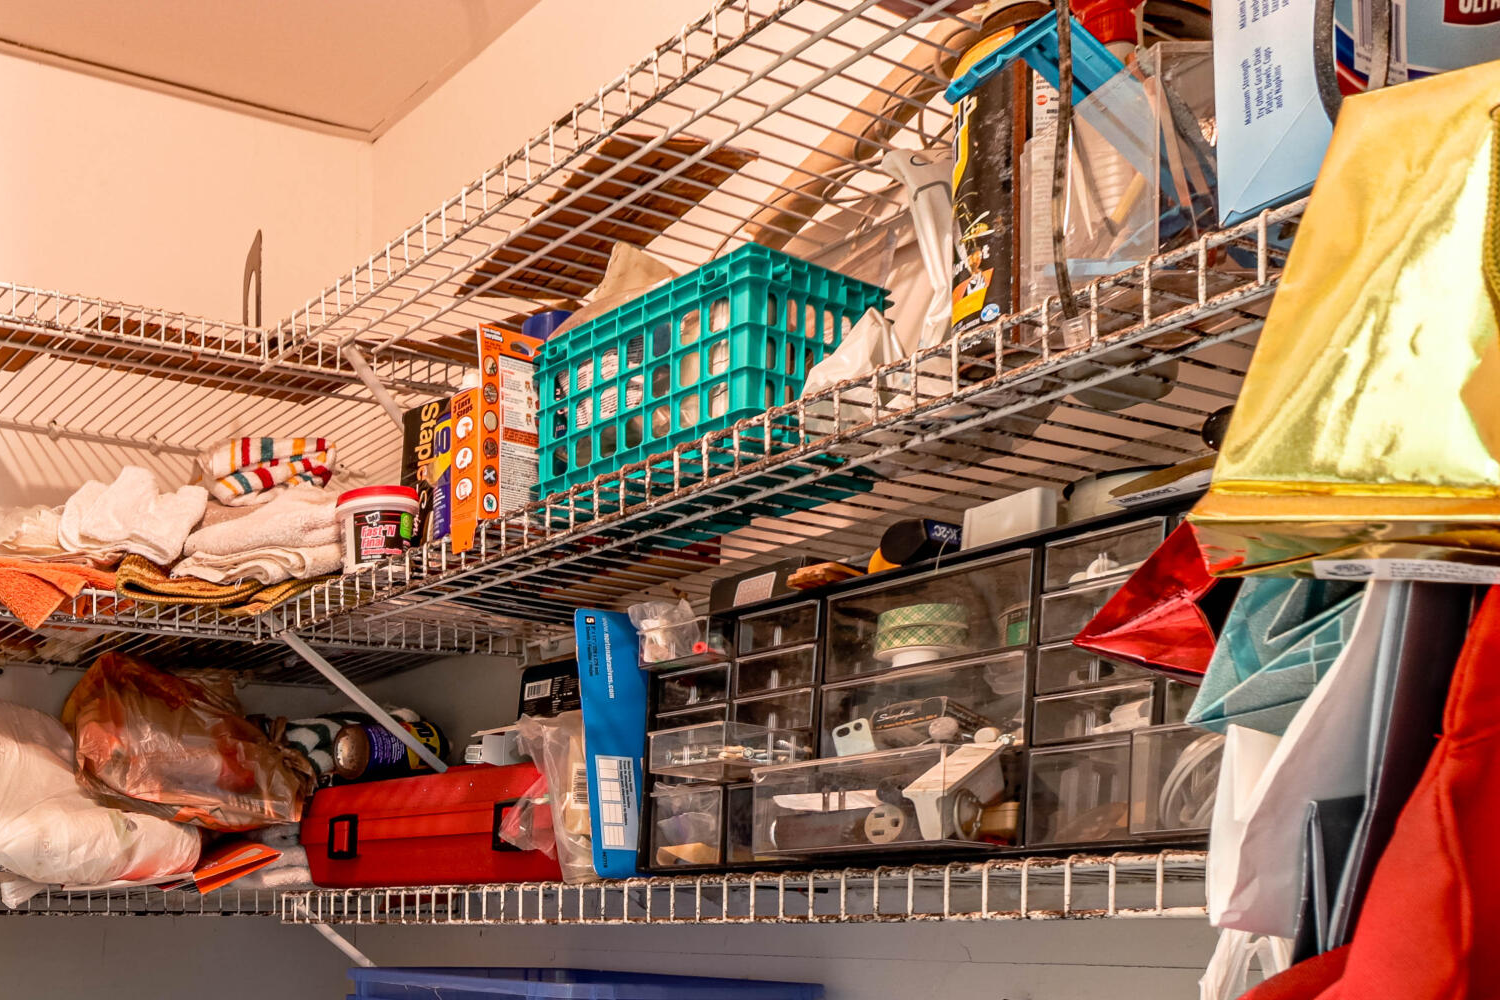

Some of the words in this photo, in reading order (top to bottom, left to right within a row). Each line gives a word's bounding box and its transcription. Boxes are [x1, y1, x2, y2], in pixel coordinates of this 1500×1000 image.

[1253, 47, 1261, 66] Dixie
[1263, 47, 1272, 64] Cups
[1240, 58, 1251, 90] Strength
[1254, 66, 1262, 86] Great
[1274, 65, 1283, 95] Napkins
[1255, 87, 1263, 107] Other
[1265, 89, 1273, 114] Plates,
[1274, 95, 1283, 109] and
[1243, 90, 1252, 126] Maximum
[1256, 107, 1265, 119] Try
[361, 525, 383, 537] Fast
[361, 536, 385, 549] Final
[602, 616, 614, 699] www.nortonabrasives.com
